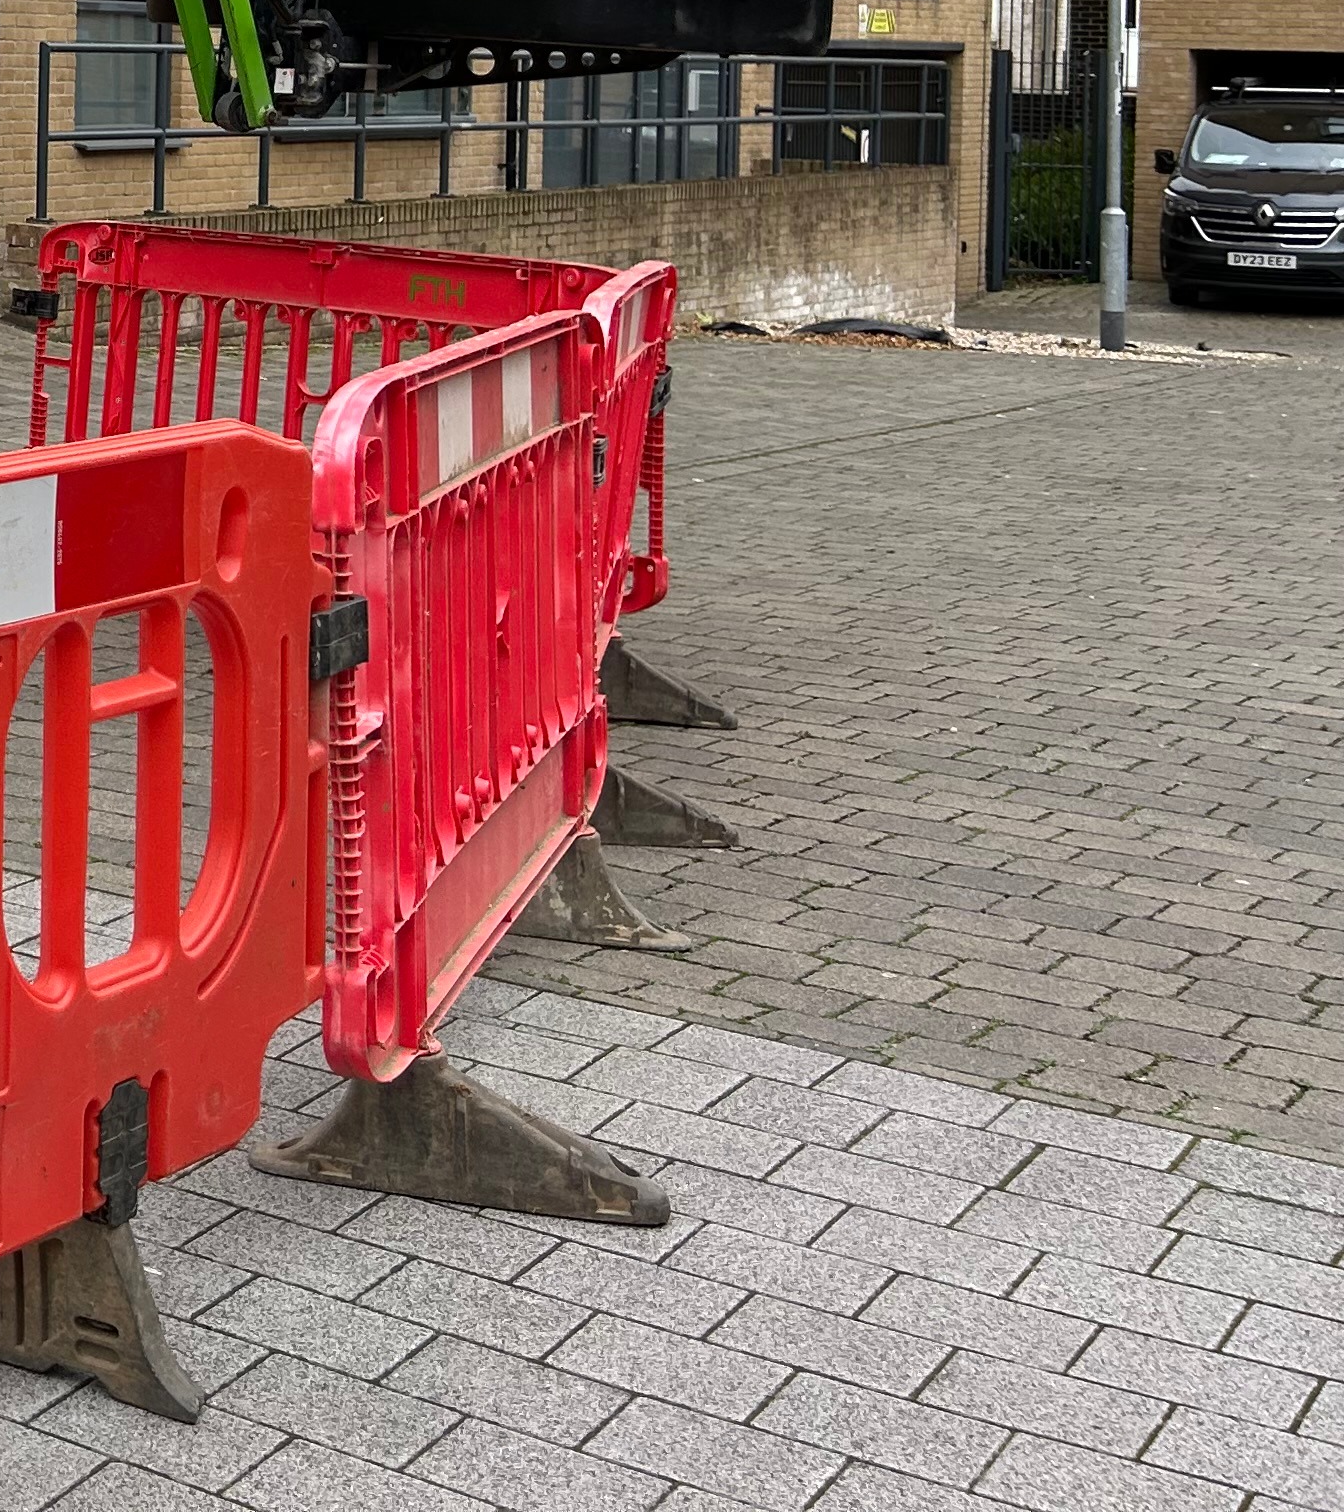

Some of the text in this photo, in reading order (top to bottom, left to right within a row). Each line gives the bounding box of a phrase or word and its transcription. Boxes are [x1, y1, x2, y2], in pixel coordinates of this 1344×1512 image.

[1233, 253, 1292, 267] DY23 EEZ
[409, 273, 466, 307] FTH
